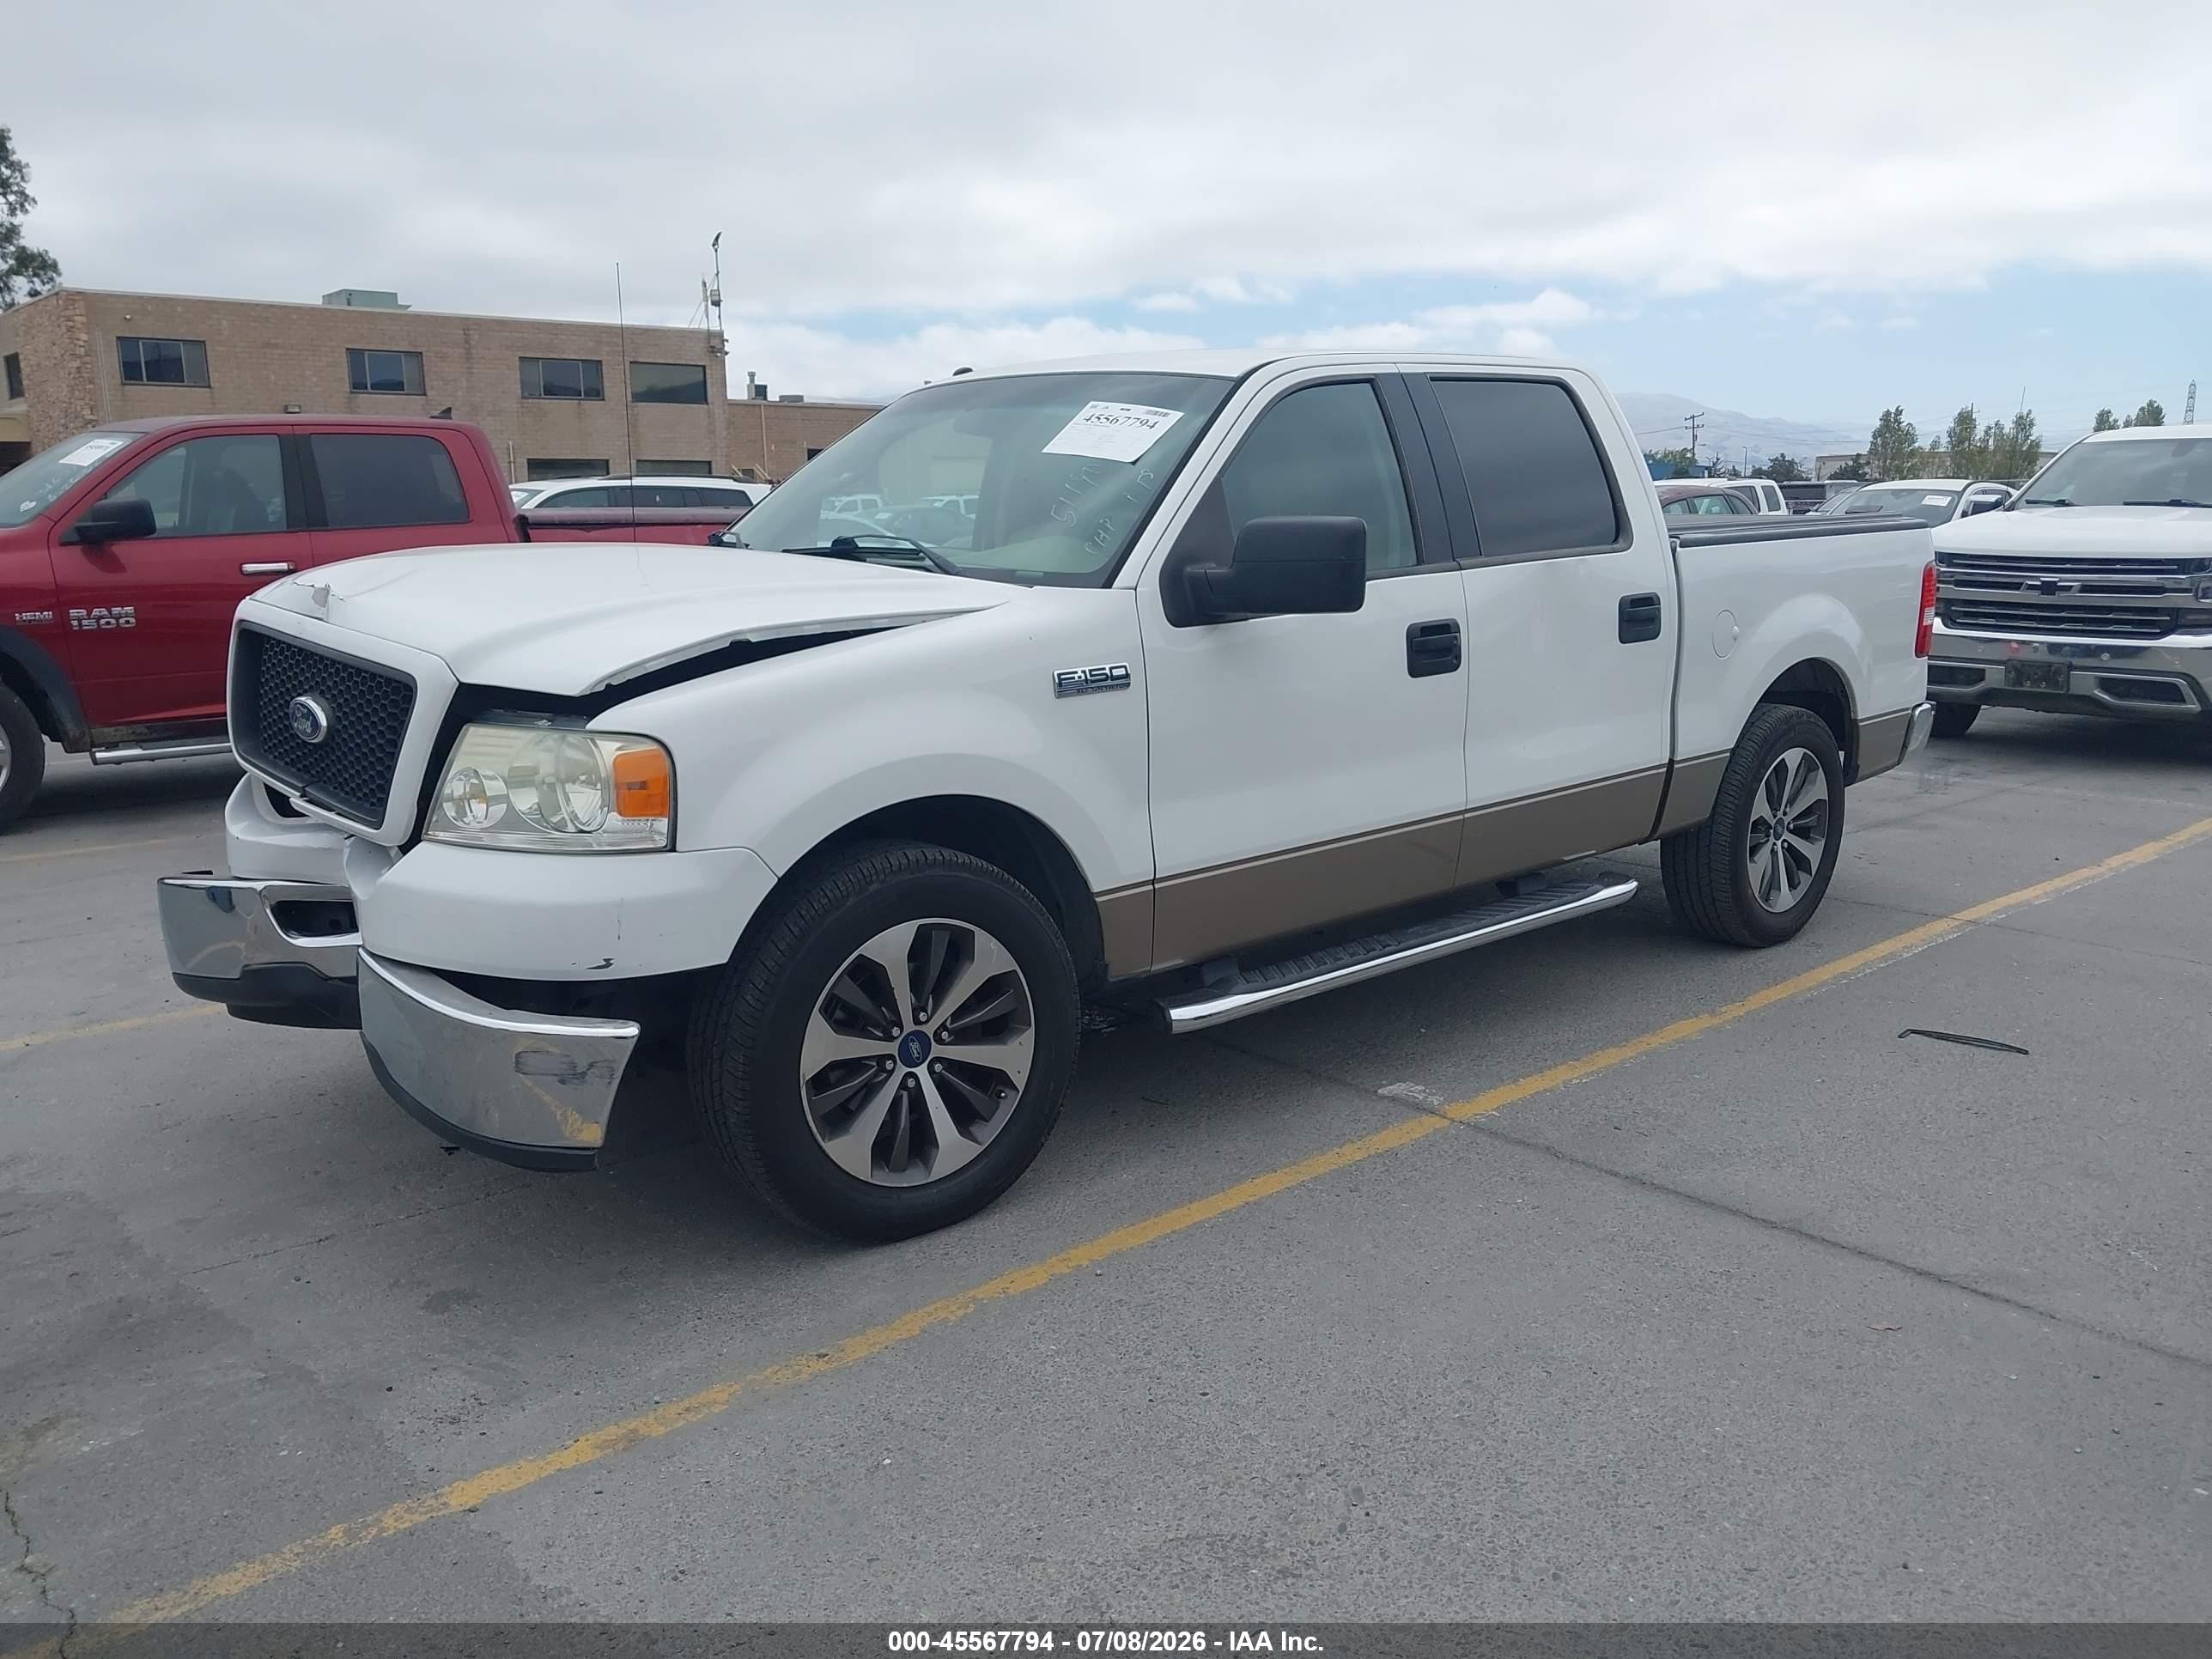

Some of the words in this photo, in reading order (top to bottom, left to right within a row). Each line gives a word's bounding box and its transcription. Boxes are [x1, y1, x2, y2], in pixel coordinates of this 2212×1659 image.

[1083, 413, 1160, 429] 45567794
[15, 611, 52, 621] HEMI
[69, 606, 135, 619] RAM
[70, 617, 136, 629] 1500
[294, 704, 313, 733] Ford
